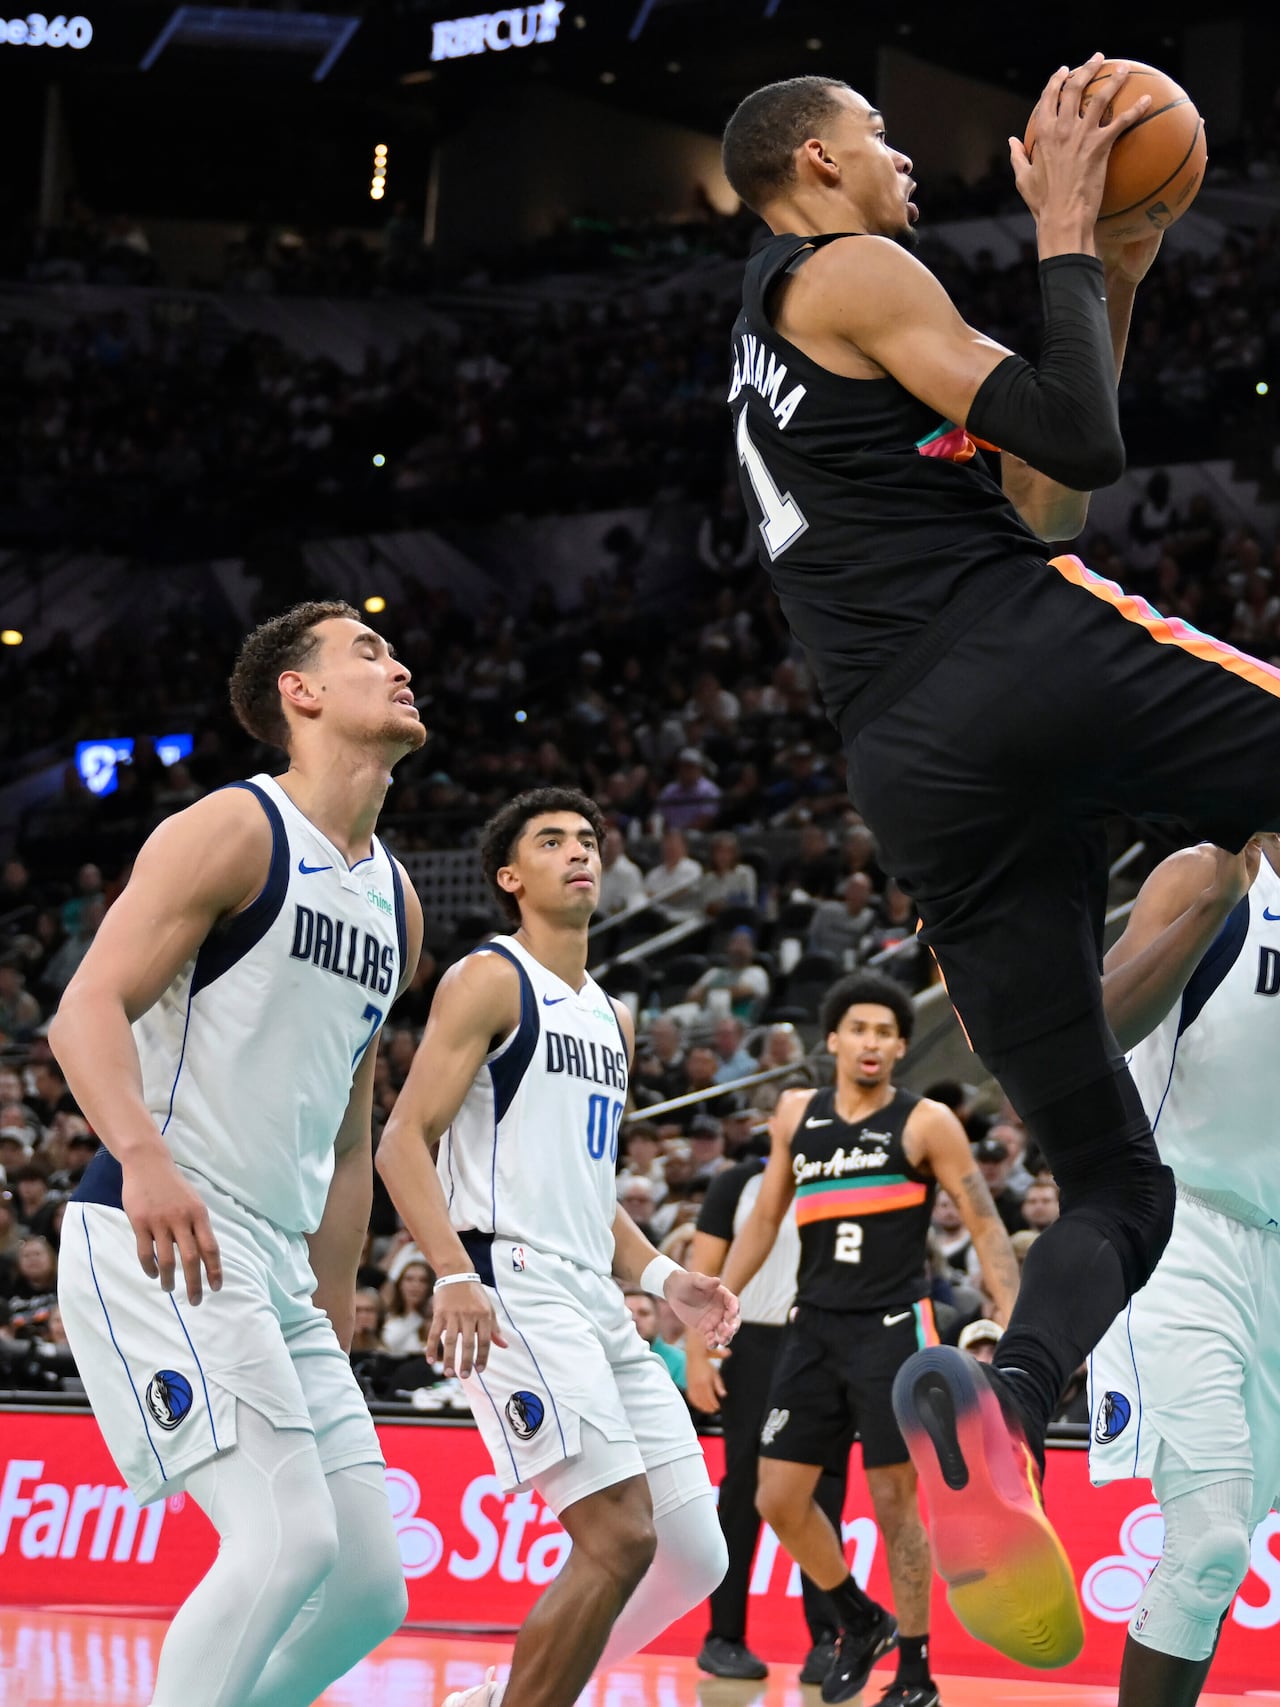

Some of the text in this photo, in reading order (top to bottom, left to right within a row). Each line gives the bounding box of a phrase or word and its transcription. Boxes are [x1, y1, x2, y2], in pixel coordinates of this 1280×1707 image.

[737, 400, 810, 563] 1
[367, 888, 393, 916] chime
[289, 903, 395, 998] DALLAS
[546, 1030, 626, 1092] DALLAS
[835, 1220, 864, 1264] 2
